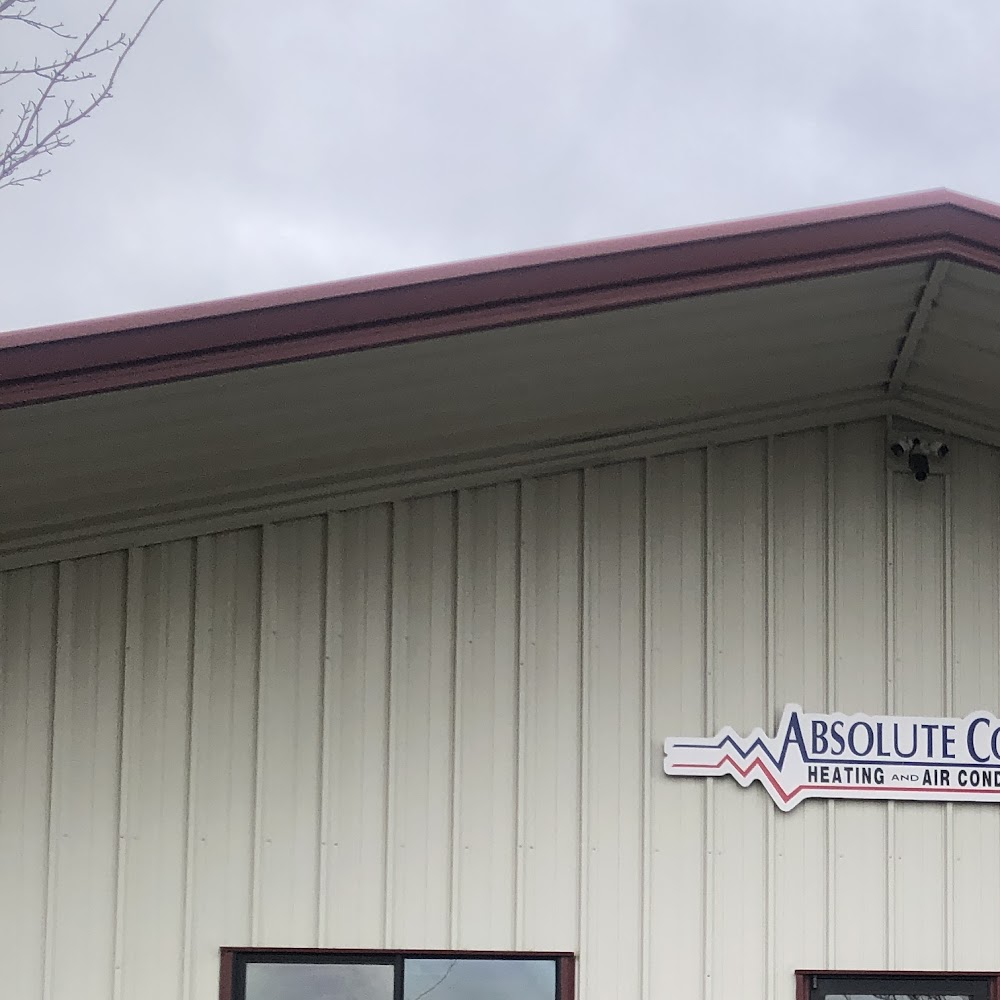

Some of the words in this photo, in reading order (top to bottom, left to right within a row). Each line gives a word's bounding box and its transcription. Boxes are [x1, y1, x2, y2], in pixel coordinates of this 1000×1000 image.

[780, 711, 956, 760] ABSOLUTE
[807, 765, 885, 785] HEATING
[890, 773, 920, 783] AND
[922, 769, 950, 787] AIR
